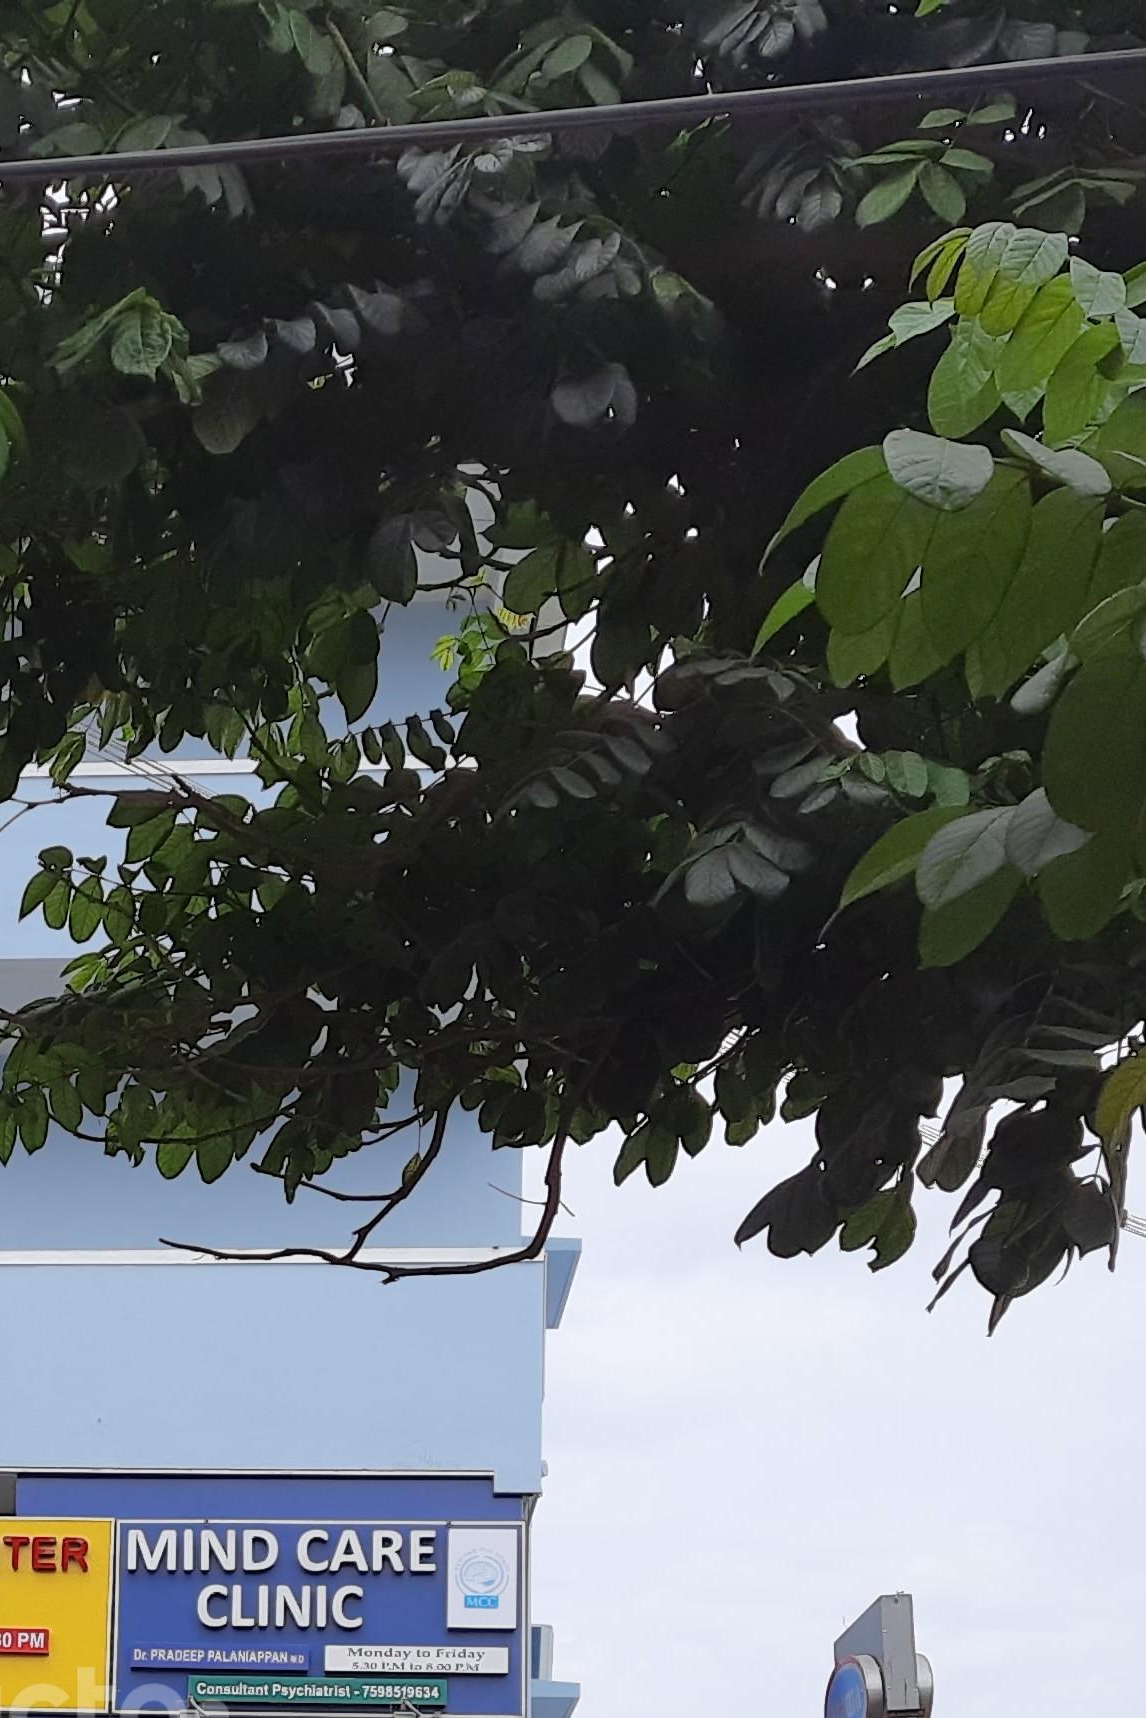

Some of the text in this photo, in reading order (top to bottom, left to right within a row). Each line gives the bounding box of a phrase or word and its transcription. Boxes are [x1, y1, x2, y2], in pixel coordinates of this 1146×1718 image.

[126, 1528, 279, 1573] MIND
[296, 1529, 438, 1575] CARE
[196, 1584, 364, 1630] CLINIC
[466, 1596, 497, 1607] MCC
[17, 1633, 45, 1650] PM
[150, 1648, 205, 1663] PRADEEP
[207, 1649, 288, 1664] PALANIAPPAN
[347, 1647, 486, 1661] Monday to Friday
[351, 1661, 378, 1671] 5.30
[425, 1663, 452, 1672] 8.00
[196, 1682, 268, 1697] Consultant
[271, 1683, 351, 1701] Psychiatrist
[361, 1685, 440, 1700] 7598519634
